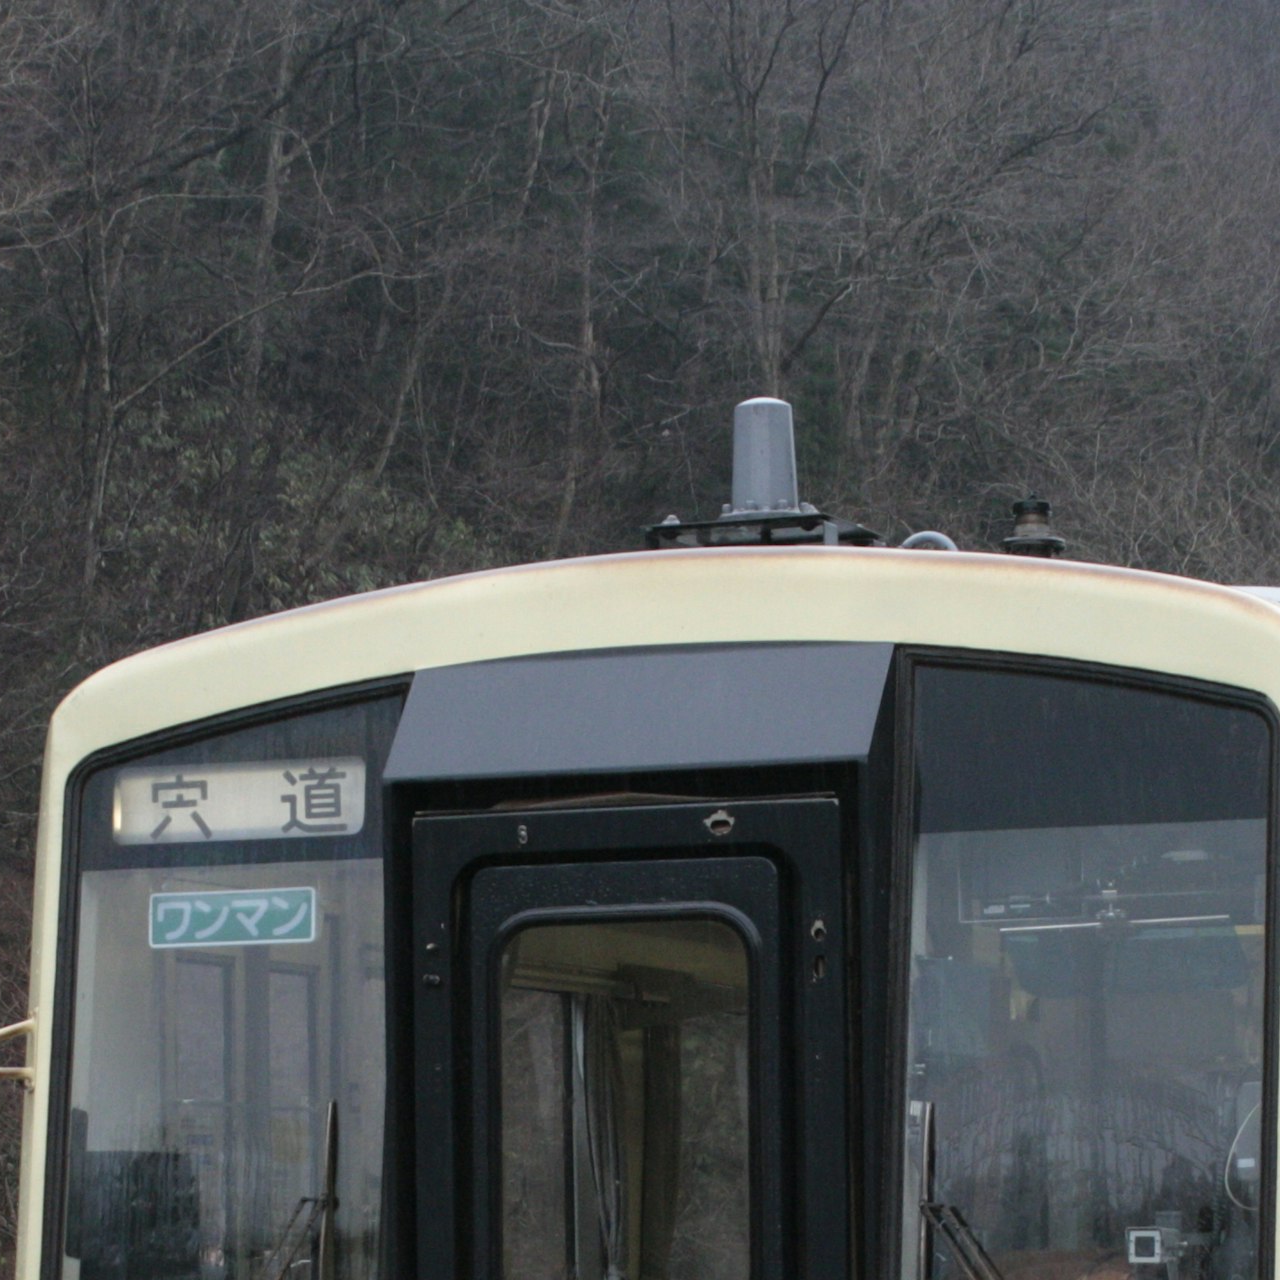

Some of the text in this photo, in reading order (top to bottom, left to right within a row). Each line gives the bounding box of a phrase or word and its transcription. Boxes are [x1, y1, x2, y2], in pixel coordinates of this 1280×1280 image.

[149, 765, 349, 840] 宍道
[156, 894, 309, 941] ワンマン
